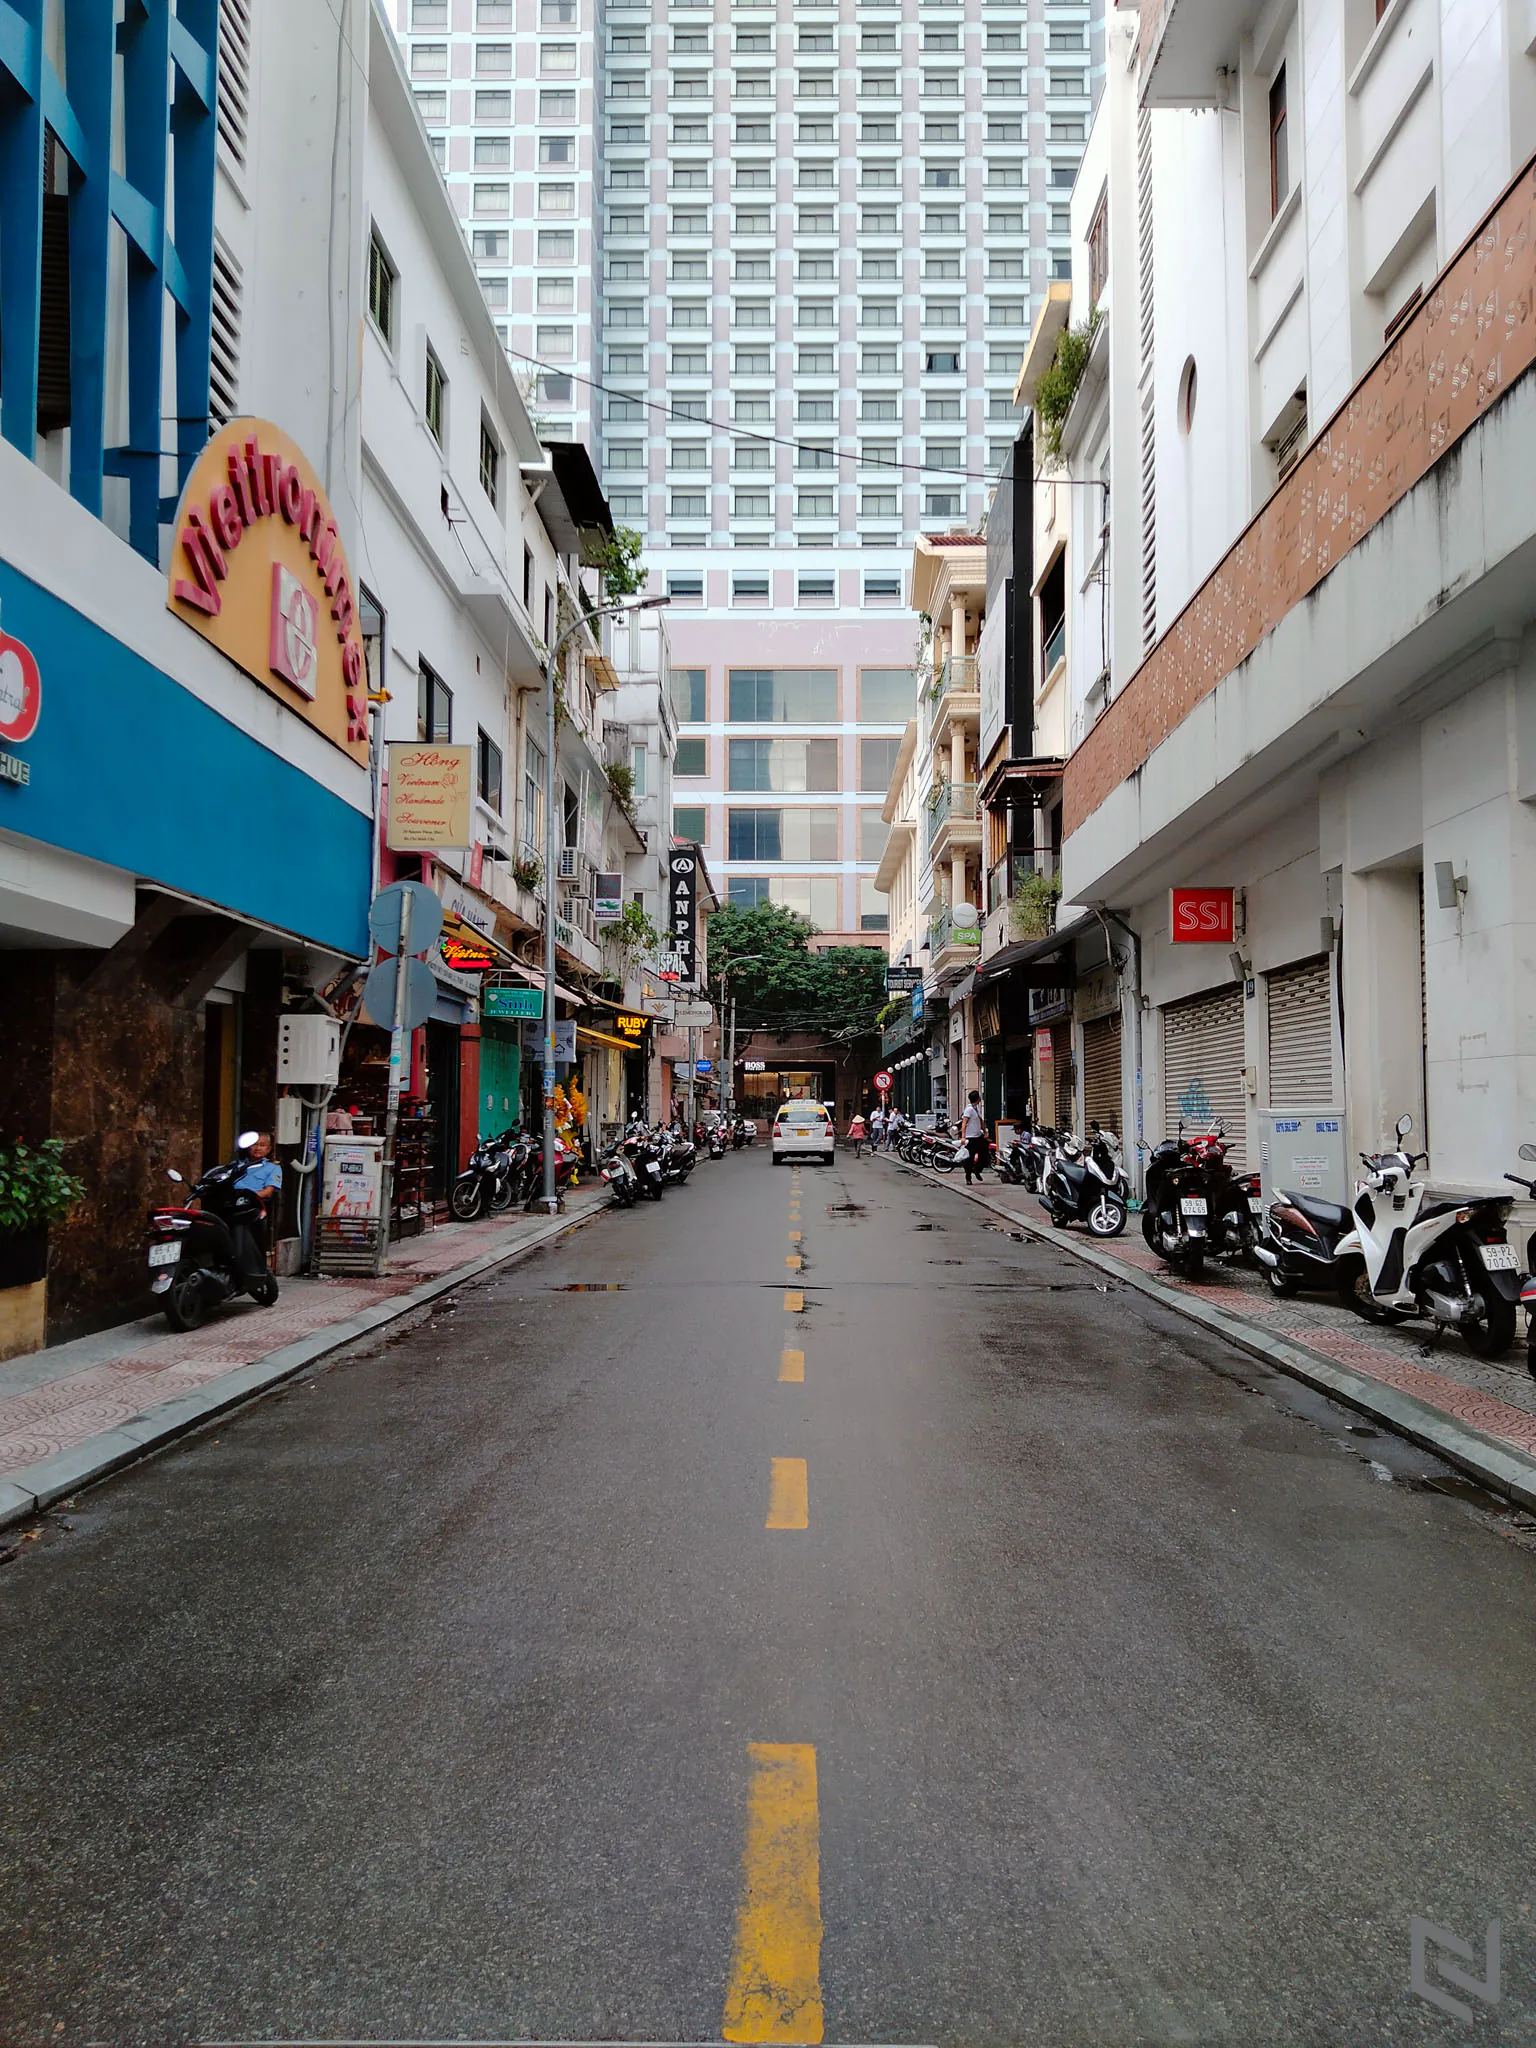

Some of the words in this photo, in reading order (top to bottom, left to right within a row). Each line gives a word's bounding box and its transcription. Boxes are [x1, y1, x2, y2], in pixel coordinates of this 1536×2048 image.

[174, 434, 367, 741] Viettronimex
[397, 773, 440, 786] Vietnam
[395, 793, 444, 804] Handmade
[1179, 901, 1228, 930] SSI
[957, 932, 976, 940] SPA
[660, 952, 679, 973] SPA
[498, 999, 534, 1011] Sinh
[617, 1016, 648, 1028] RUBY
[624, 1027, 641, 1036] Shop
